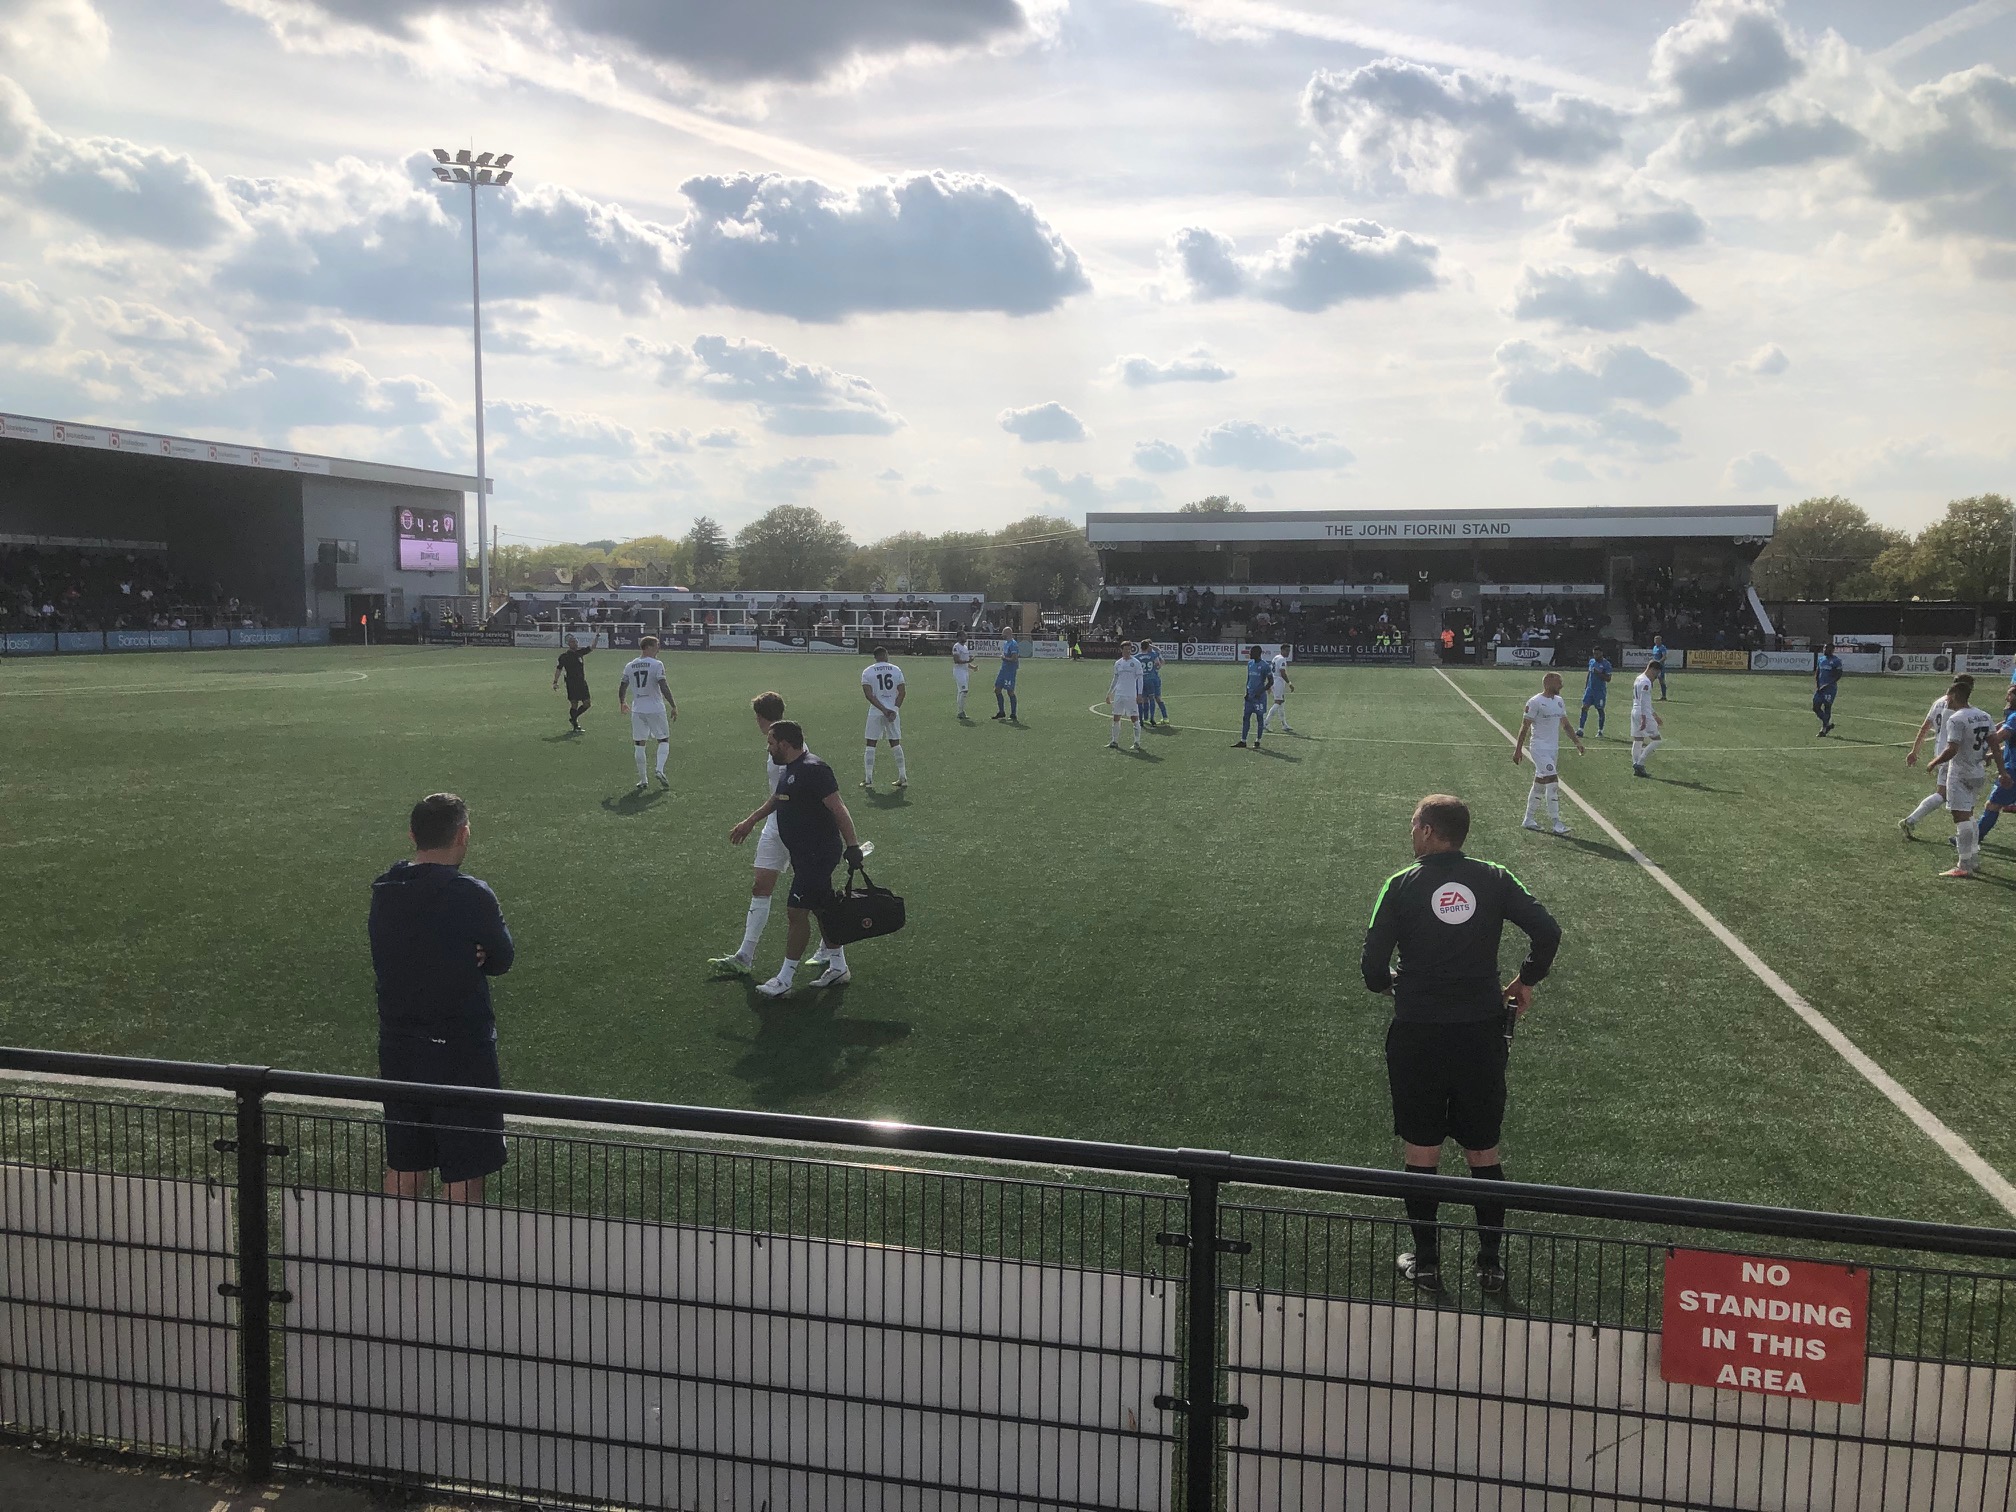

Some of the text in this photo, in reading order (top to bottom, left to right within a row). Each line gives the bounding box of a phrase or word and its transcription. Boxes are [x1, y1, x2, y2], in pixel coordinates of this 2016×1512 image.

[1325, 523, 1511, 536] THE JOHN FIORINI STAND
[1197, 644, 1235, 652] SPITFIRE
[1298, 644, 1351, 653] GLEMNET
[1356, 645, 1411, 654] GLEMNET
[1513, 649, 1539, 657] CLARITY
[633, 670, 648, 688] 17
[876, 673, 893, 690] 16
[1440, 891, 1467, 906] EA
[1440, 903, 1470, 914] SPORTS
[1742, 1262, 1790, 1287] NO
[1679, 1289, 1851, 1329] STANDING
[1702, 1327, 1826, 1360] IN THIS
[1716, 1364, 1807, 1394] AREA
